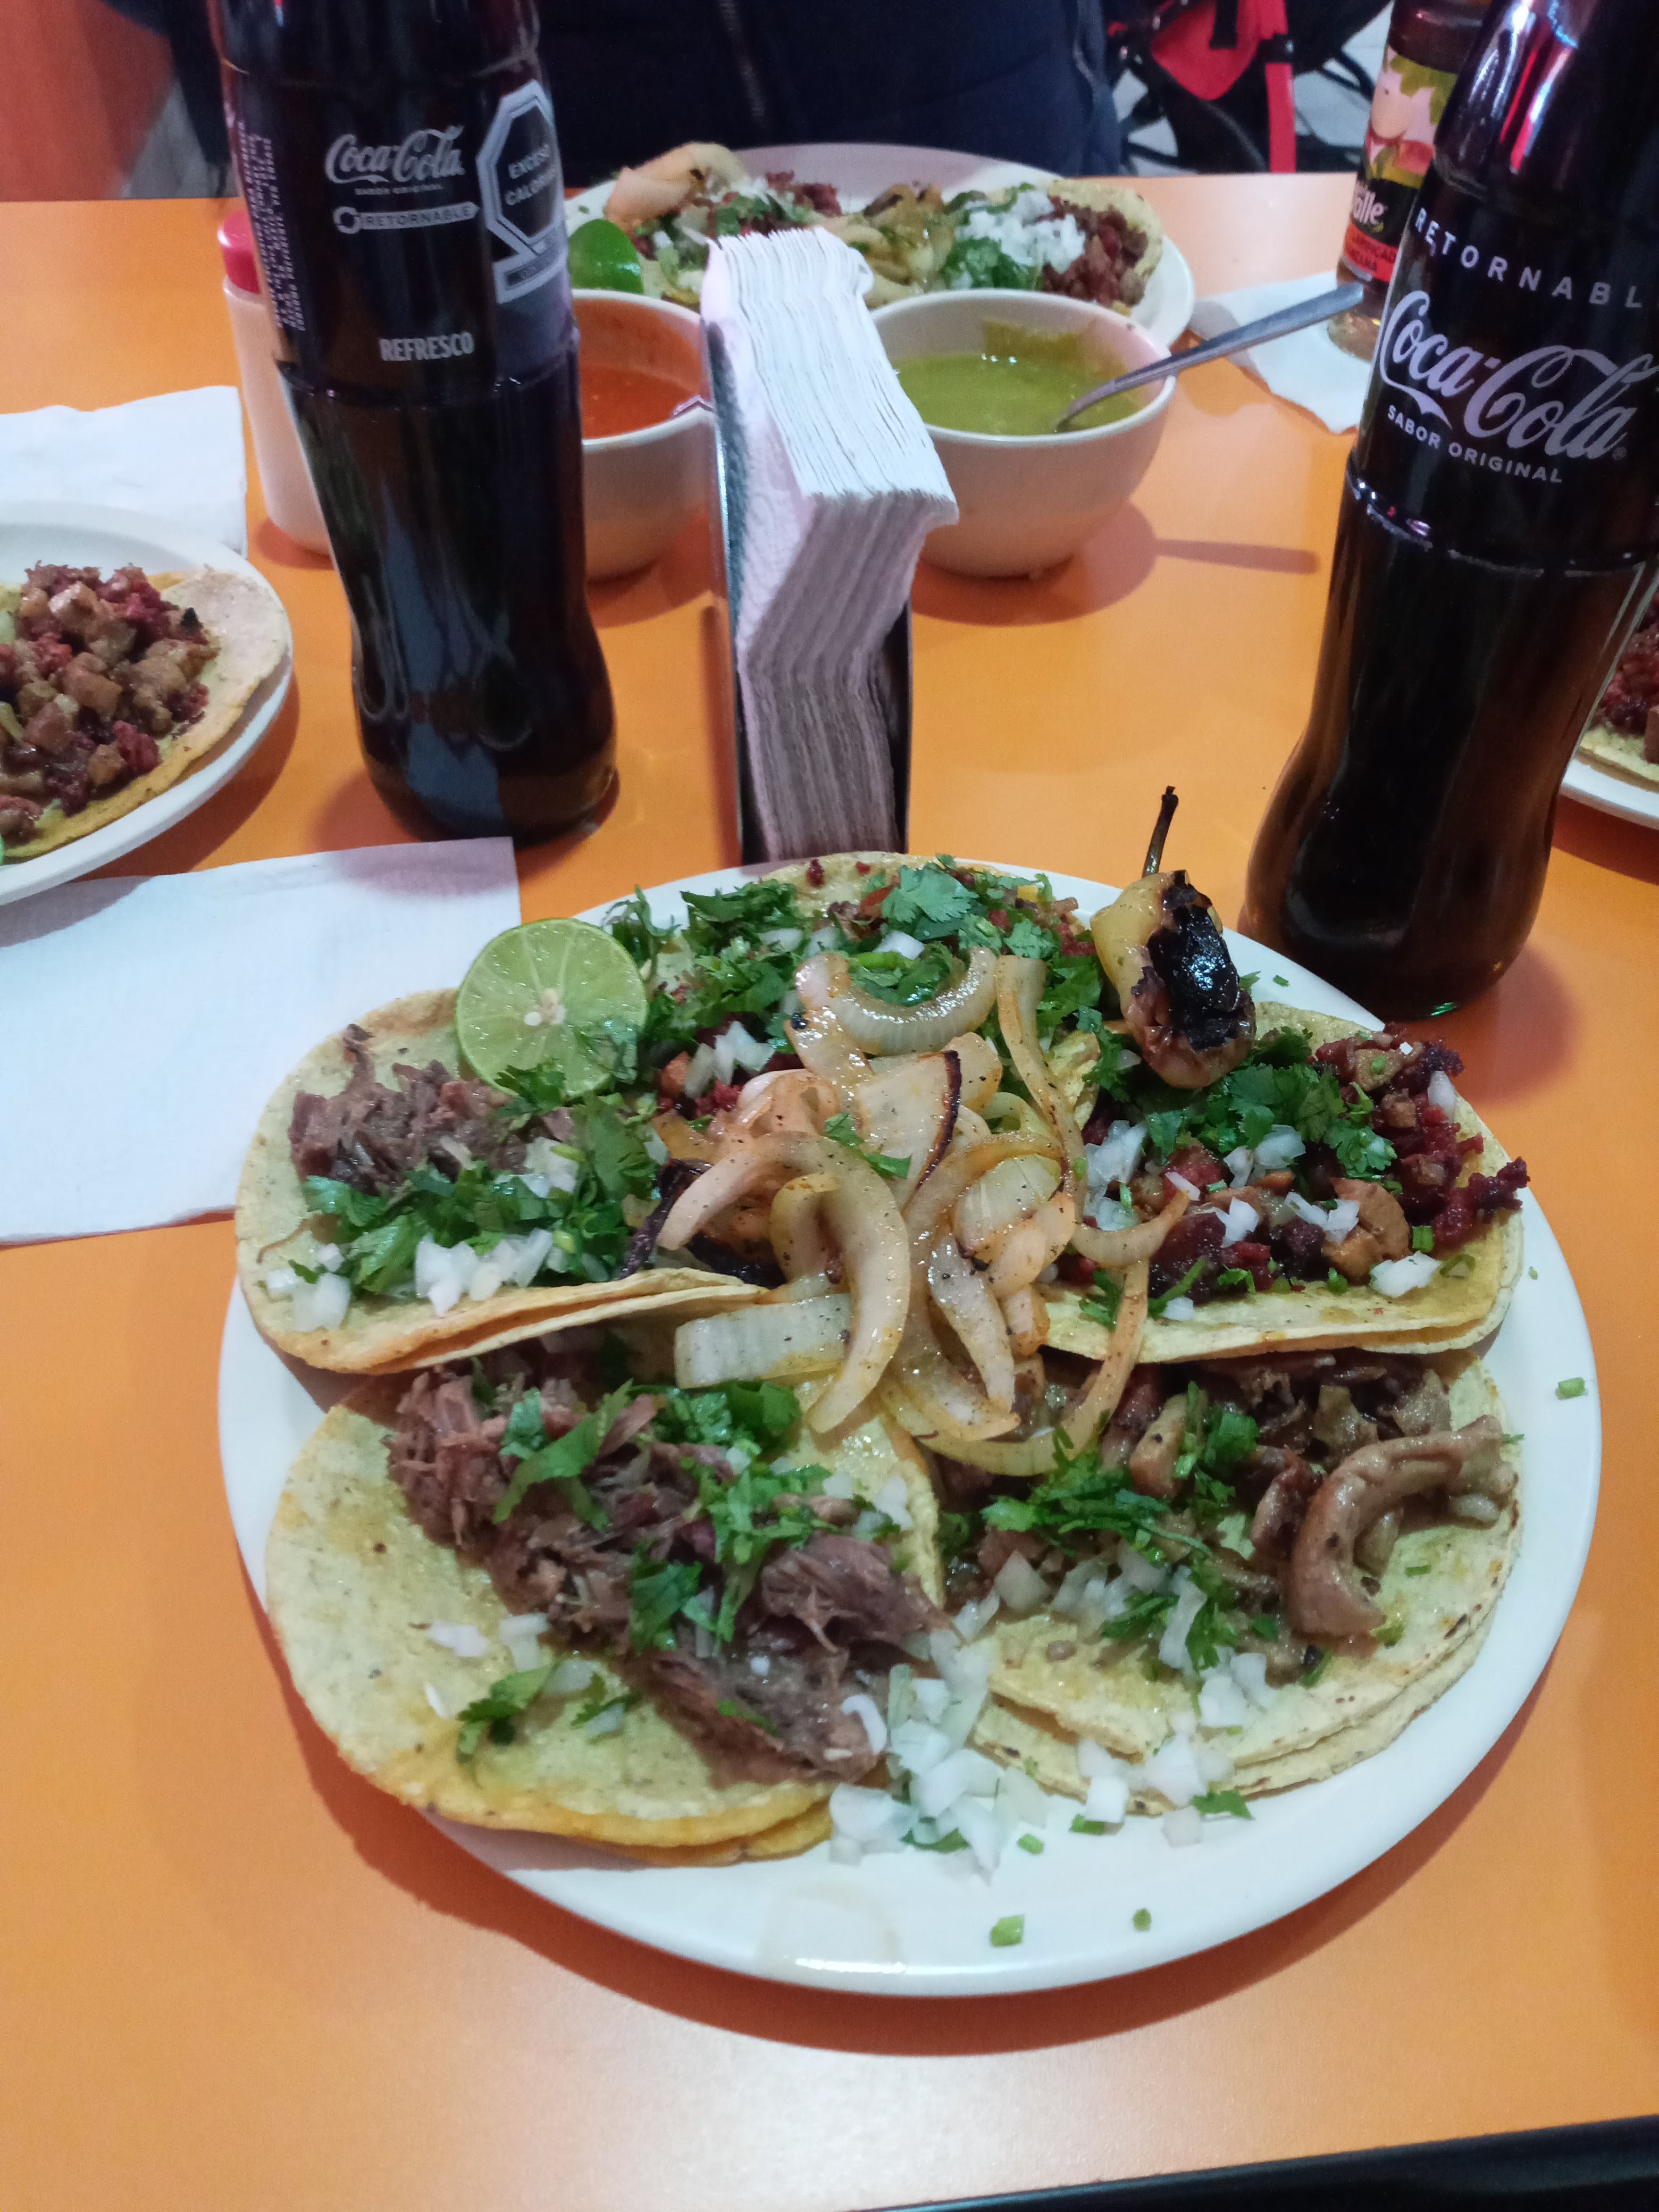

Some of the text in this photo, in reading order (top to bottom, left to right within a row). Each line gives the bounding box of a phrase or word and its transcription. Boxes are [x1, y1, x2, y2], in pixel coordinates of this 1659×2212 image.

[325, 125, 466, 184] Coca-Cola
[1414, 207, 1659, 308] RETORNABL
[379, 331, 474, 361] REFRESCO
[1380, 290, 1659, 459] Coca-Cola
[1387, 404, 1563, 483] SABOR ORIGINAL
